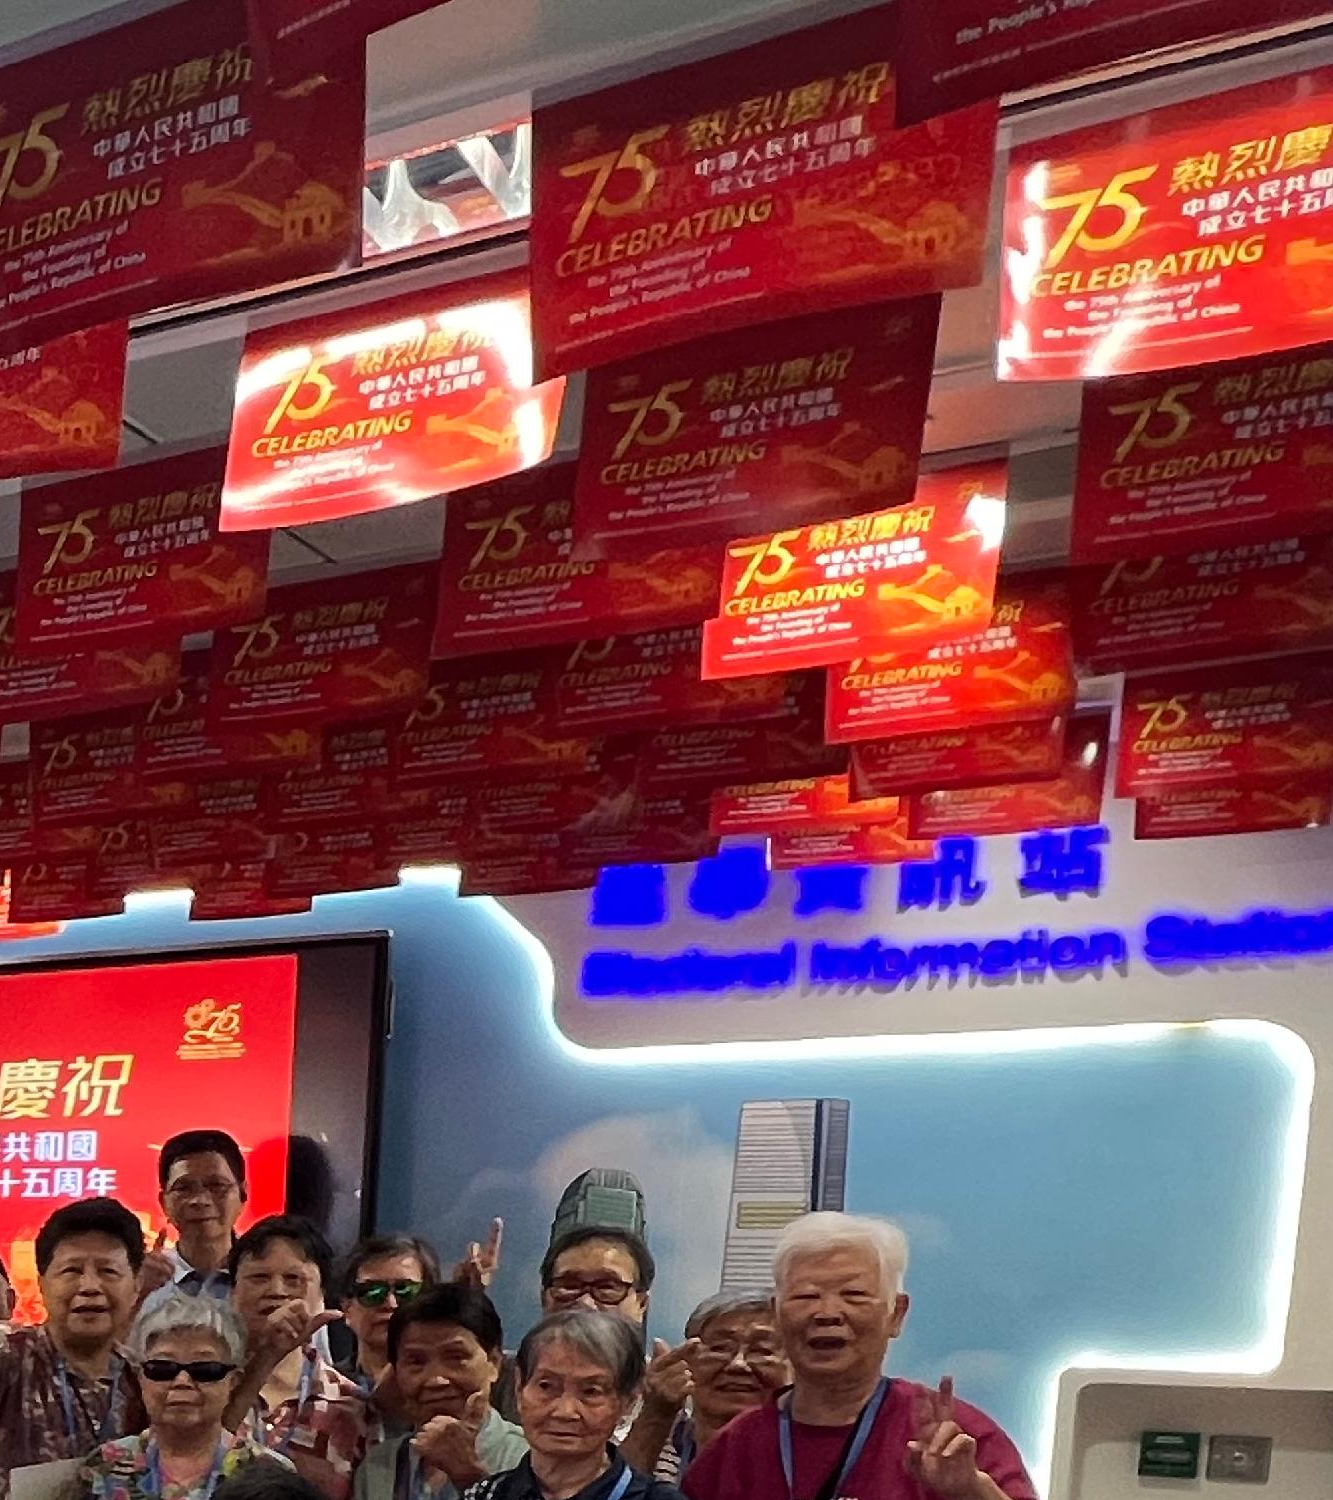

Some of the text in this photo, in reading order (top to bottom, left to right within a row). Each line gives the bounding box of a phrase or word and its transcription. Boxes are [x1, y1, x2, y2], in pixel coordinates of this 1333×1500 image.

[92, 95, 240, 158] 中華人民共和國
[680, 60, 890, 152] 熱烈慶祝
[107, 116, 252, 180] 成立七十五周年
[694, 114, 864, 177] 中華人民共和國
[710, 136, 877, 196] 成立七十五周年
[559, 123, 671, 244] 75
[555, 193, 774, 277] CELEBRATING
[1041, 164, 1159, 271] 75
[1030, 233, 1267, 298] CELEBRATING
[275, 355, 343, 434] 75
[358, 356, 480, 394] 中華人民共和國
[368, 371, 487, 410] 成立七十五周年
[251, 410, 414, 458] CELEBRATING
[607, 378, 693, 460] 75
[1107, 381, 1203, 464] 75
[600, 439, 768, 486] CELEBRATING
[1099, 441, 1286, 488] CELEBRATING
[37, 508, 100, 575] 75
[729, 528, 804, 596] 75
[33, 559, 159, 597] CELEBRATING
[724, 579, 865, 616] CELEBRATING
[810, 926, 1125, 984] Information
